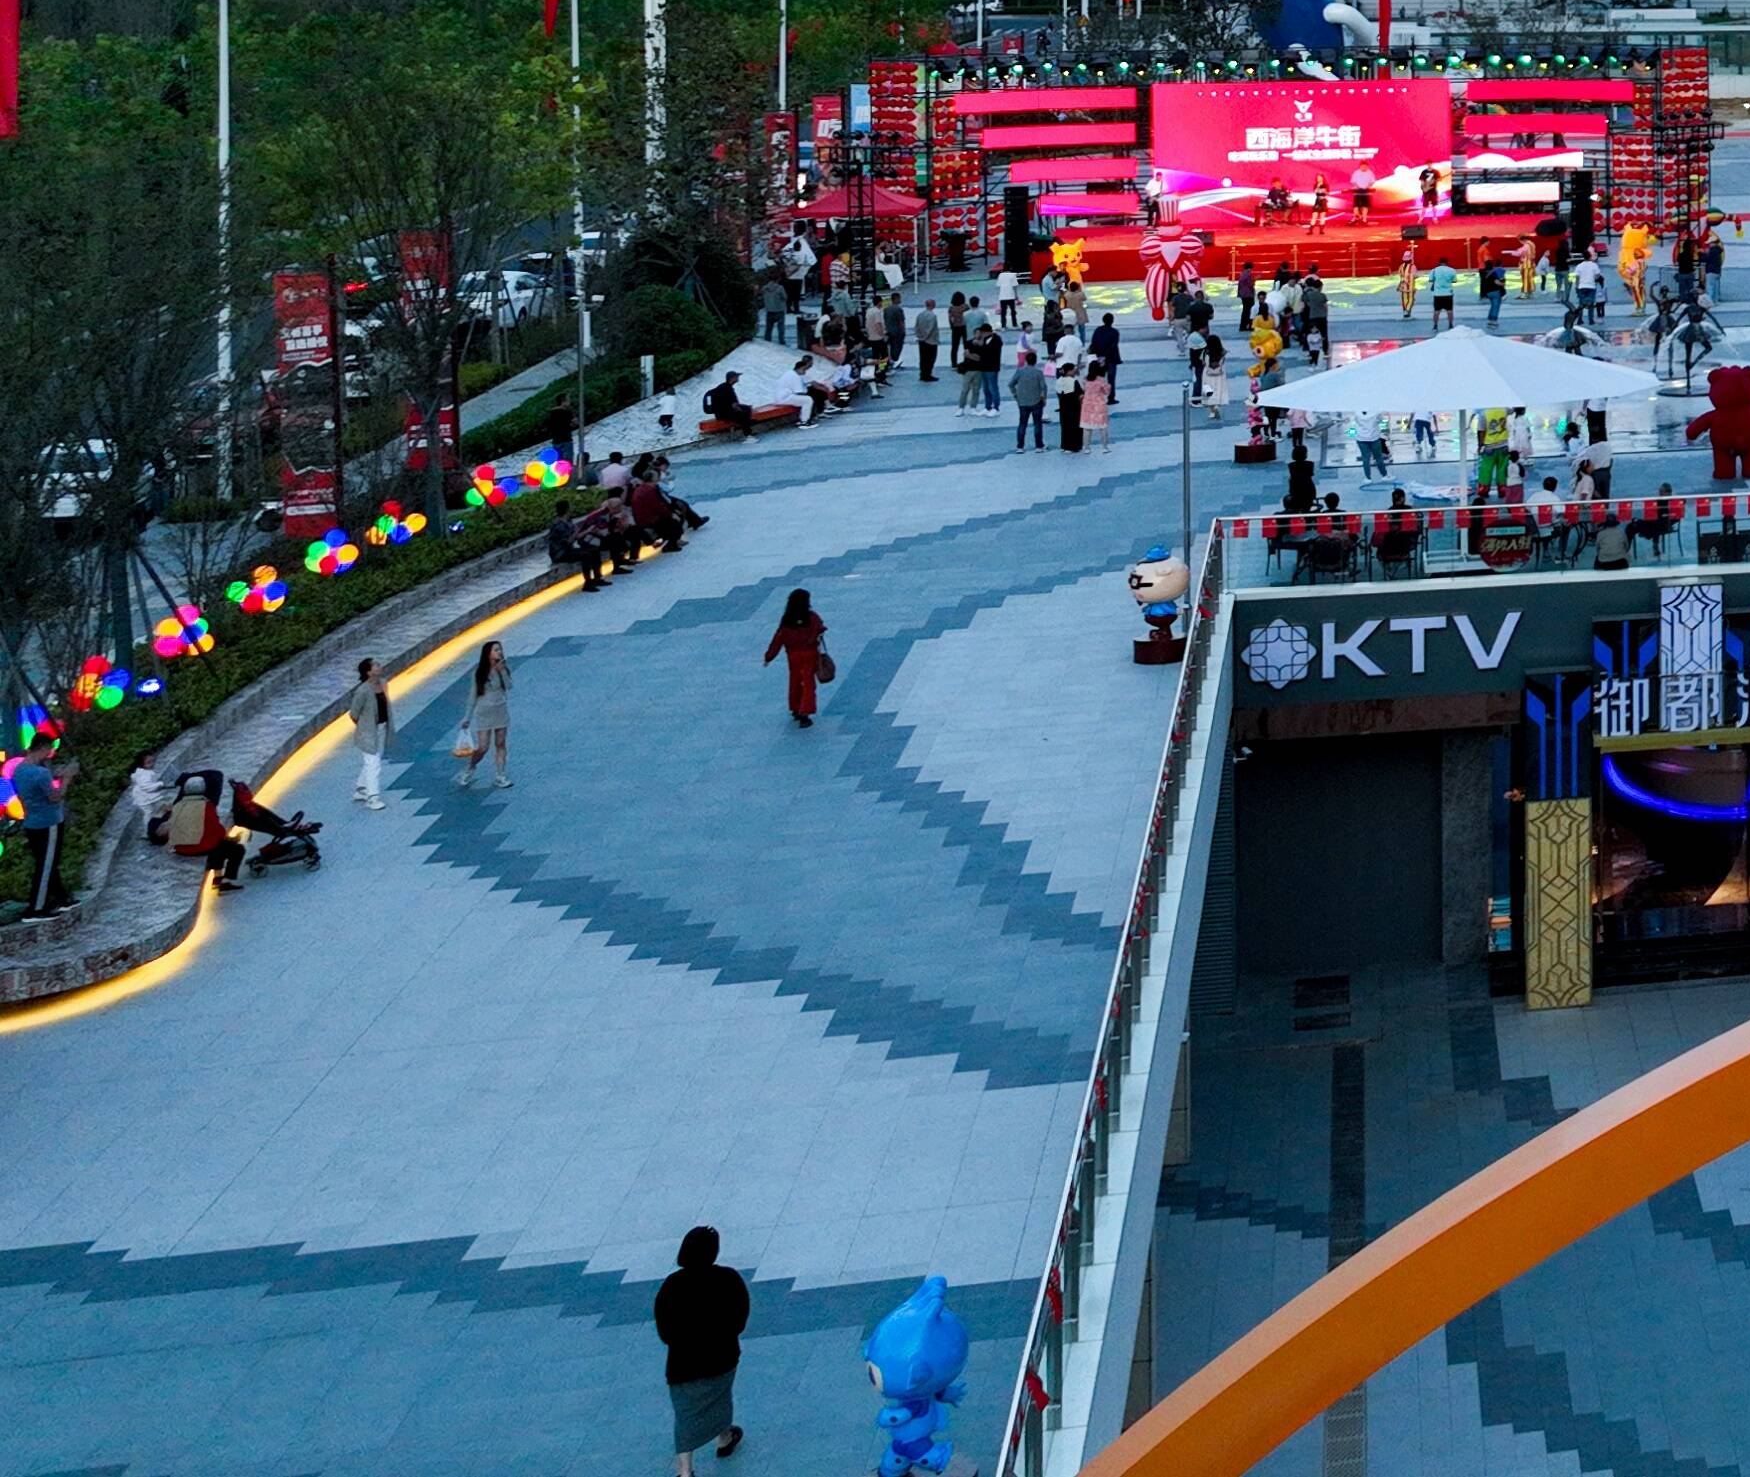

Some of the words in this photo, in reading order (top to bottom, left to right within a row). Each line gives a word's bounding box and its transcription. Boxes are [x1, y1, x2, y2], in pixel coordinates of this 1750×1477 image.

[1245, 125, 1361, 150] 西海岸牛街
[1320, 611, 1523, 680] KTV
